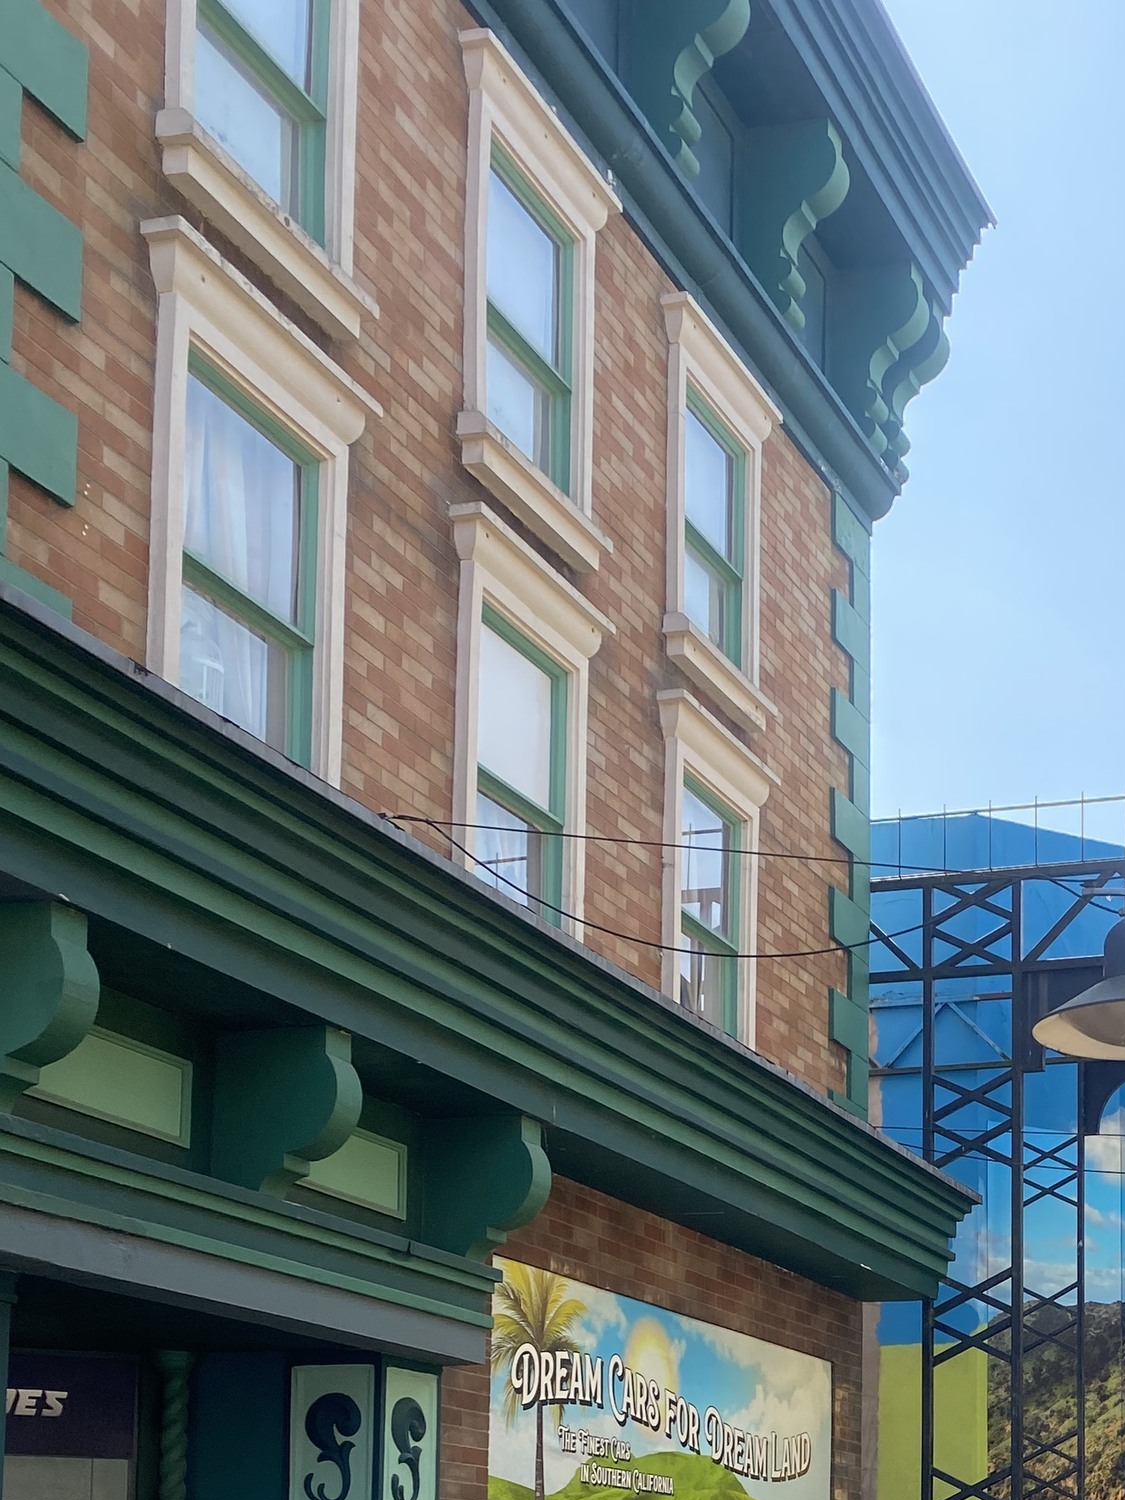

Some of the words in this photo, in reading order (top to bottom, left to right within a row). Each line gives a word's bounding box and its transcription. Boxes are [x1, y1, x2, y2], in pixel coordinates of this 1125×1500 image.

[511, 1342, 604, 1410] DREAM
[608, 1353, 660, 1431] CARS
[664, 1388, 700, 1454] FOR
[557, 1425, 577, 1452] THE
[578, 1429, 609, 1458] FINEST
[610, 1436, 632, 1463] CARS
[580, 1463, 590, 1483] IN
[590, 1462, 632, 1489] SOUTHERN
[632, 1468, 674, 1496] CALIFORNIA
